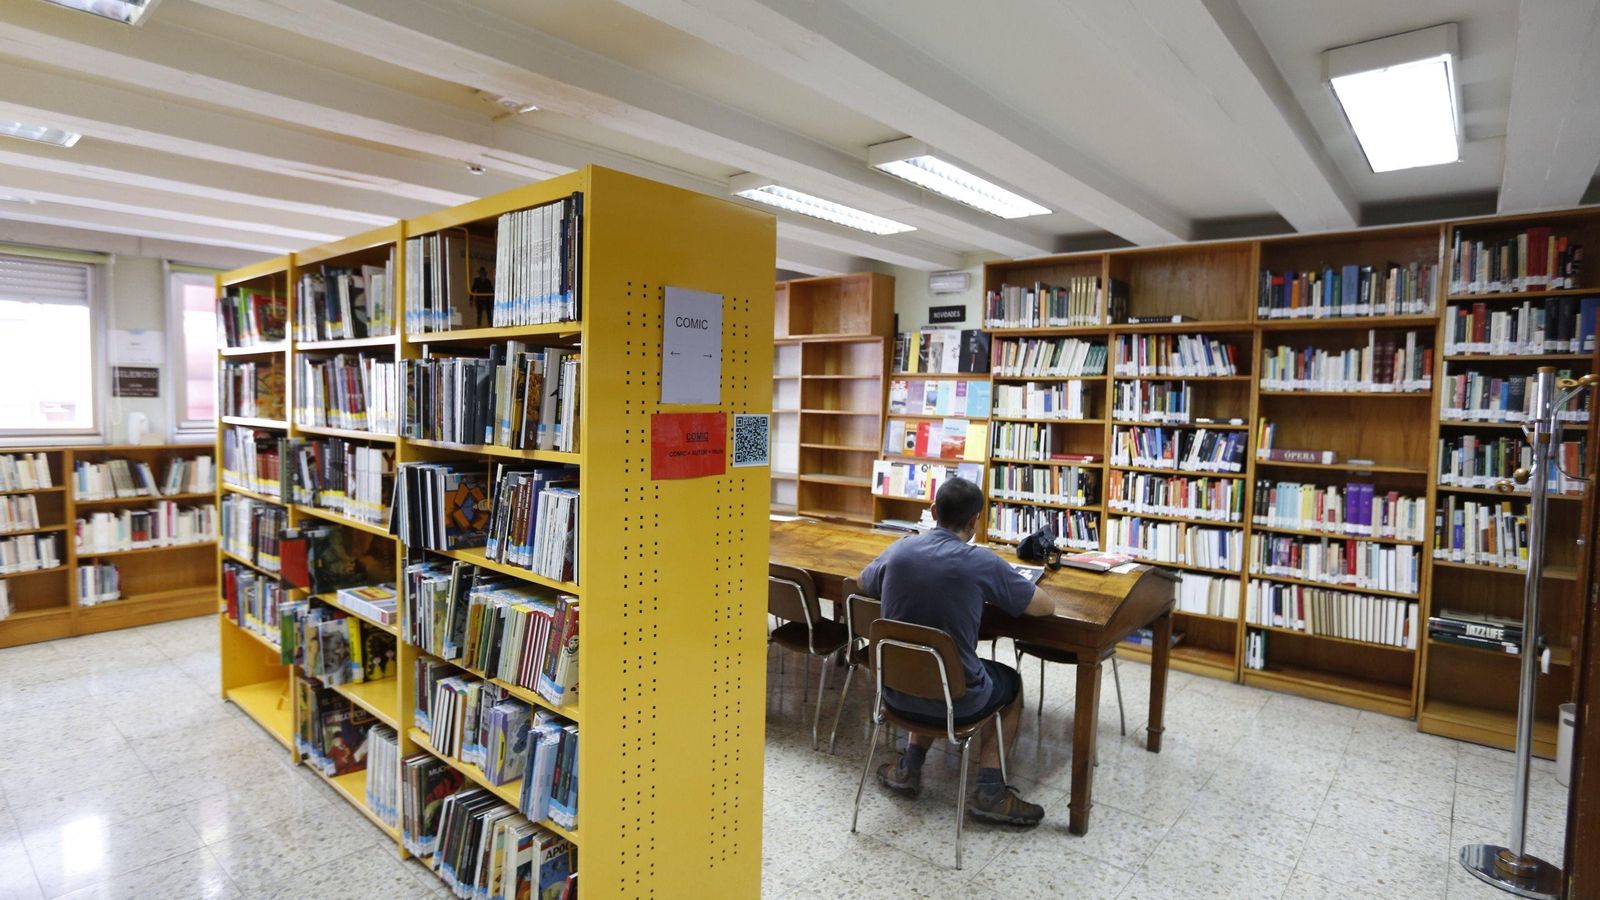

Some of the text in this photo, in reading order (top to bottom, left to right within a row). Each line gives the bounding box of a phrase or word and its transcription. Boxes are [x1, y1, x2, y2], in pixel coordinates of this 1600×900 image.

[675, 316, 709, 330] COMIC
[1465, 624, 1504, 640] JAZZ LIFE
